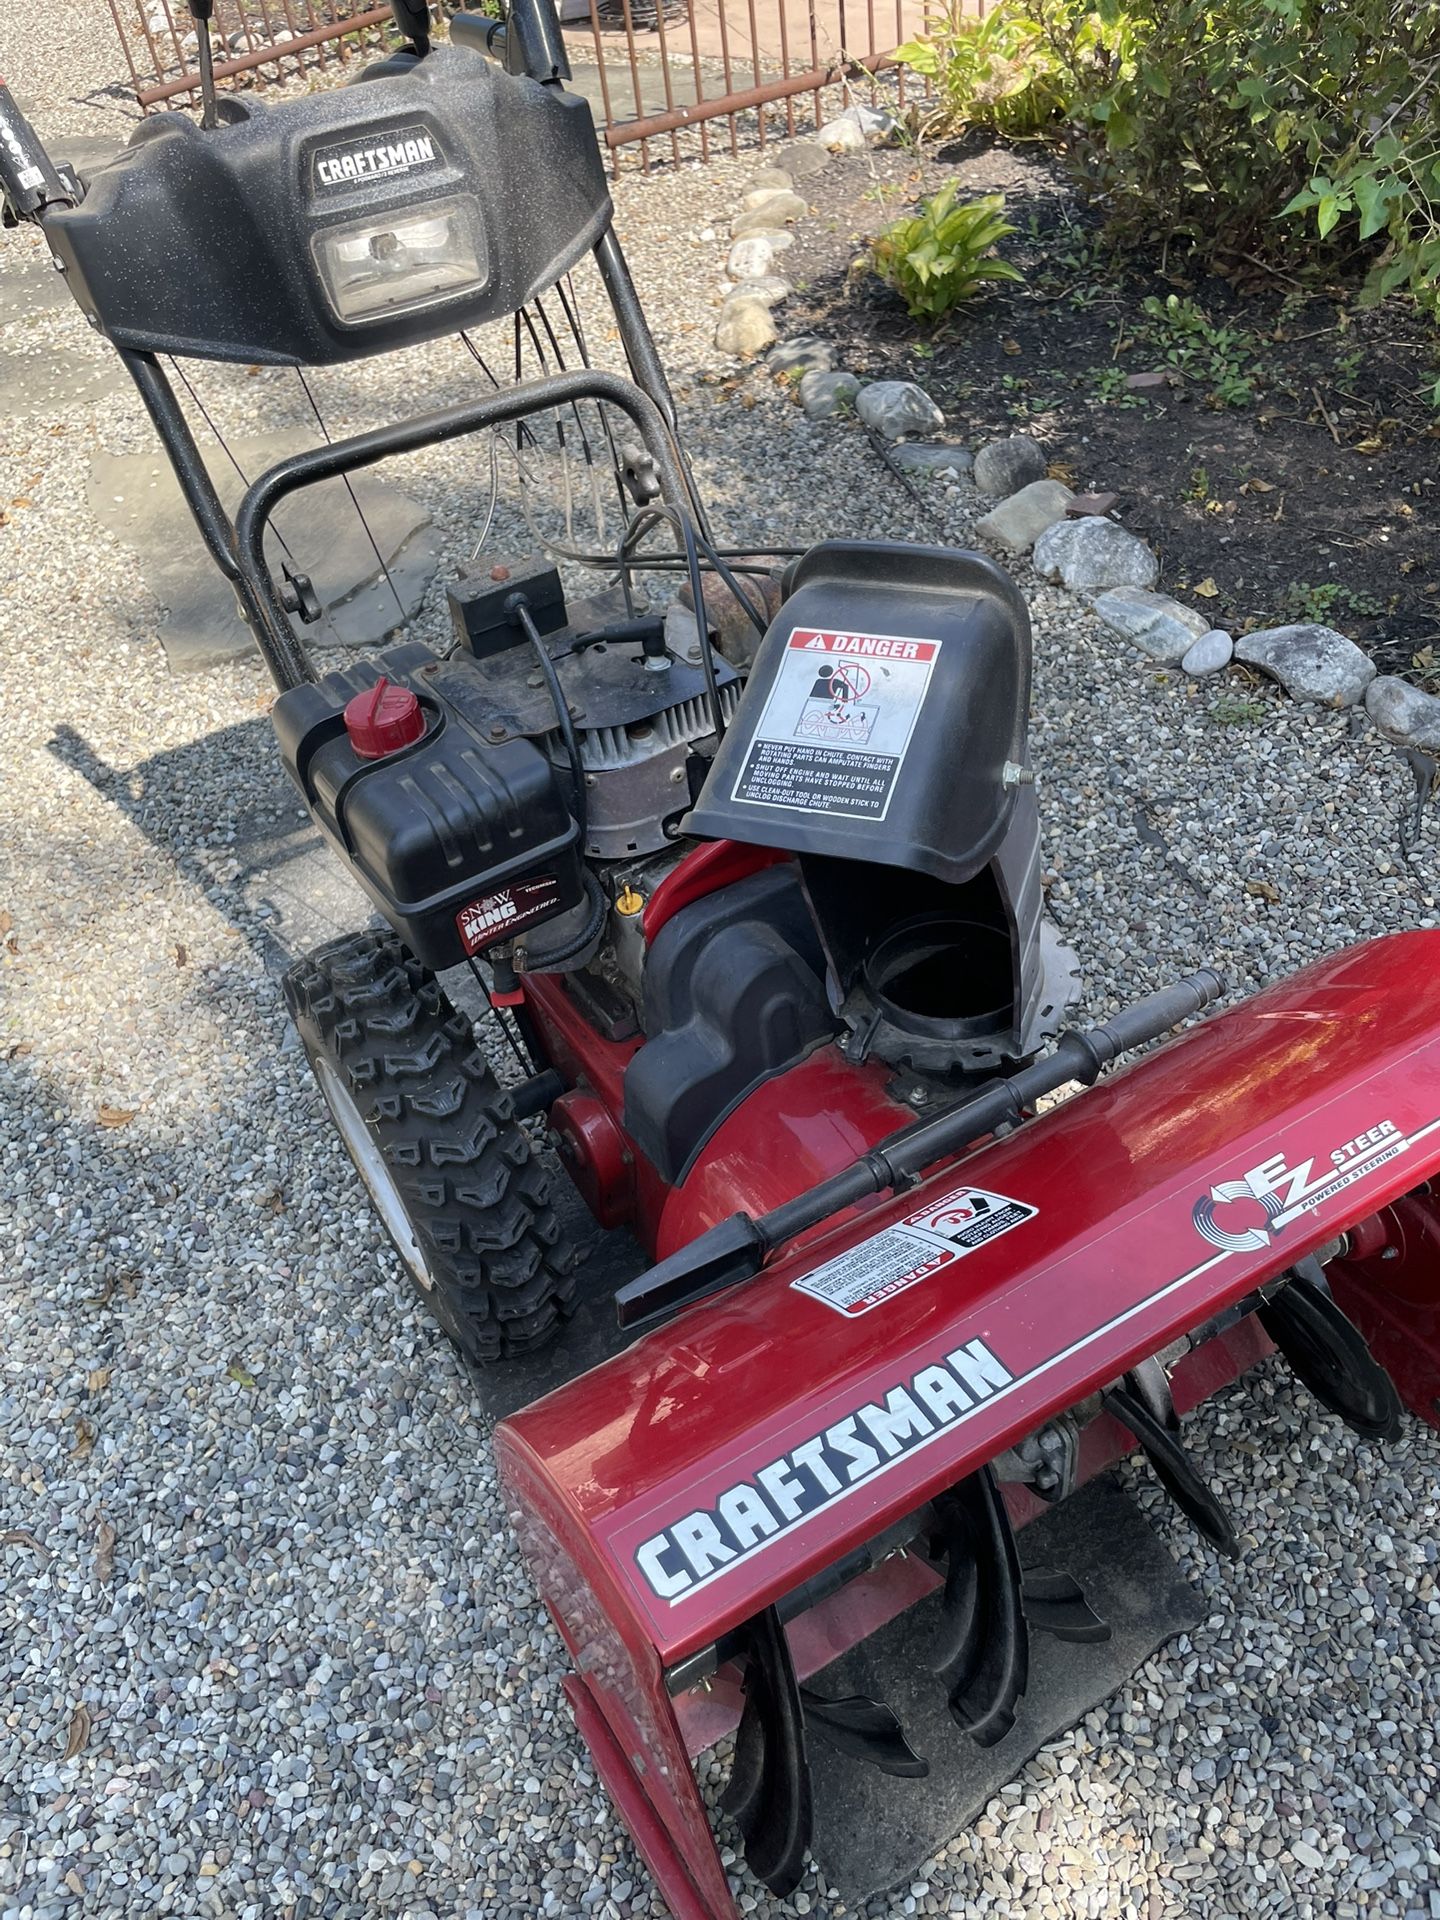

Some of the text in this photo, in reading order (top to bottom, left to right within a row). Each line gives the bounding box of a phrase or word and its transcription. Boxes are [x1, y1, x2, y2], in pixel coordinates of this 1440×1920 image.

[317, 137, 434, 183] CRAFTSMAN
[832, 636, 919, 660] DANGER
[760, 749, 791, 758] ROTATING
[792, 753, 813, 761] PARTS
[827, 758, 862, 767] AMPUTATE
[862, 762, 891, 771] FINGERS
[846, 753, 875, 762] CONTACT
[750, 776, 794, 787] UNCLOGGING.
[752, 770, 883, 792] MOVING PARTS HAVE STOPPED BEFORE
[789, 768, 814, 776] ENGINE
[831, 773, 848, 781] WAIT
[745, 791, 771, 800] UNCLOG
[771, 794, 808, 805] DISCHARGE
[760, 786, 794, 796] CLEAN-OUT
[821, 794, 849, 804] WOODEN
[849, 798, 869, 806] STICK
[464, 901, 517, 940] KING
[471, 923, 504, 946] WINTER
[1243, 1119, 1397, 1209] EZ STEER
[1301, 1146, 1400, 1210] POWERED STEERING
[922, 1190, 966, 1216] DANGER
[861, 1265, 930, 1304] DANGER
[635, 1336, 1014, 1598] CRAFTSMAN
